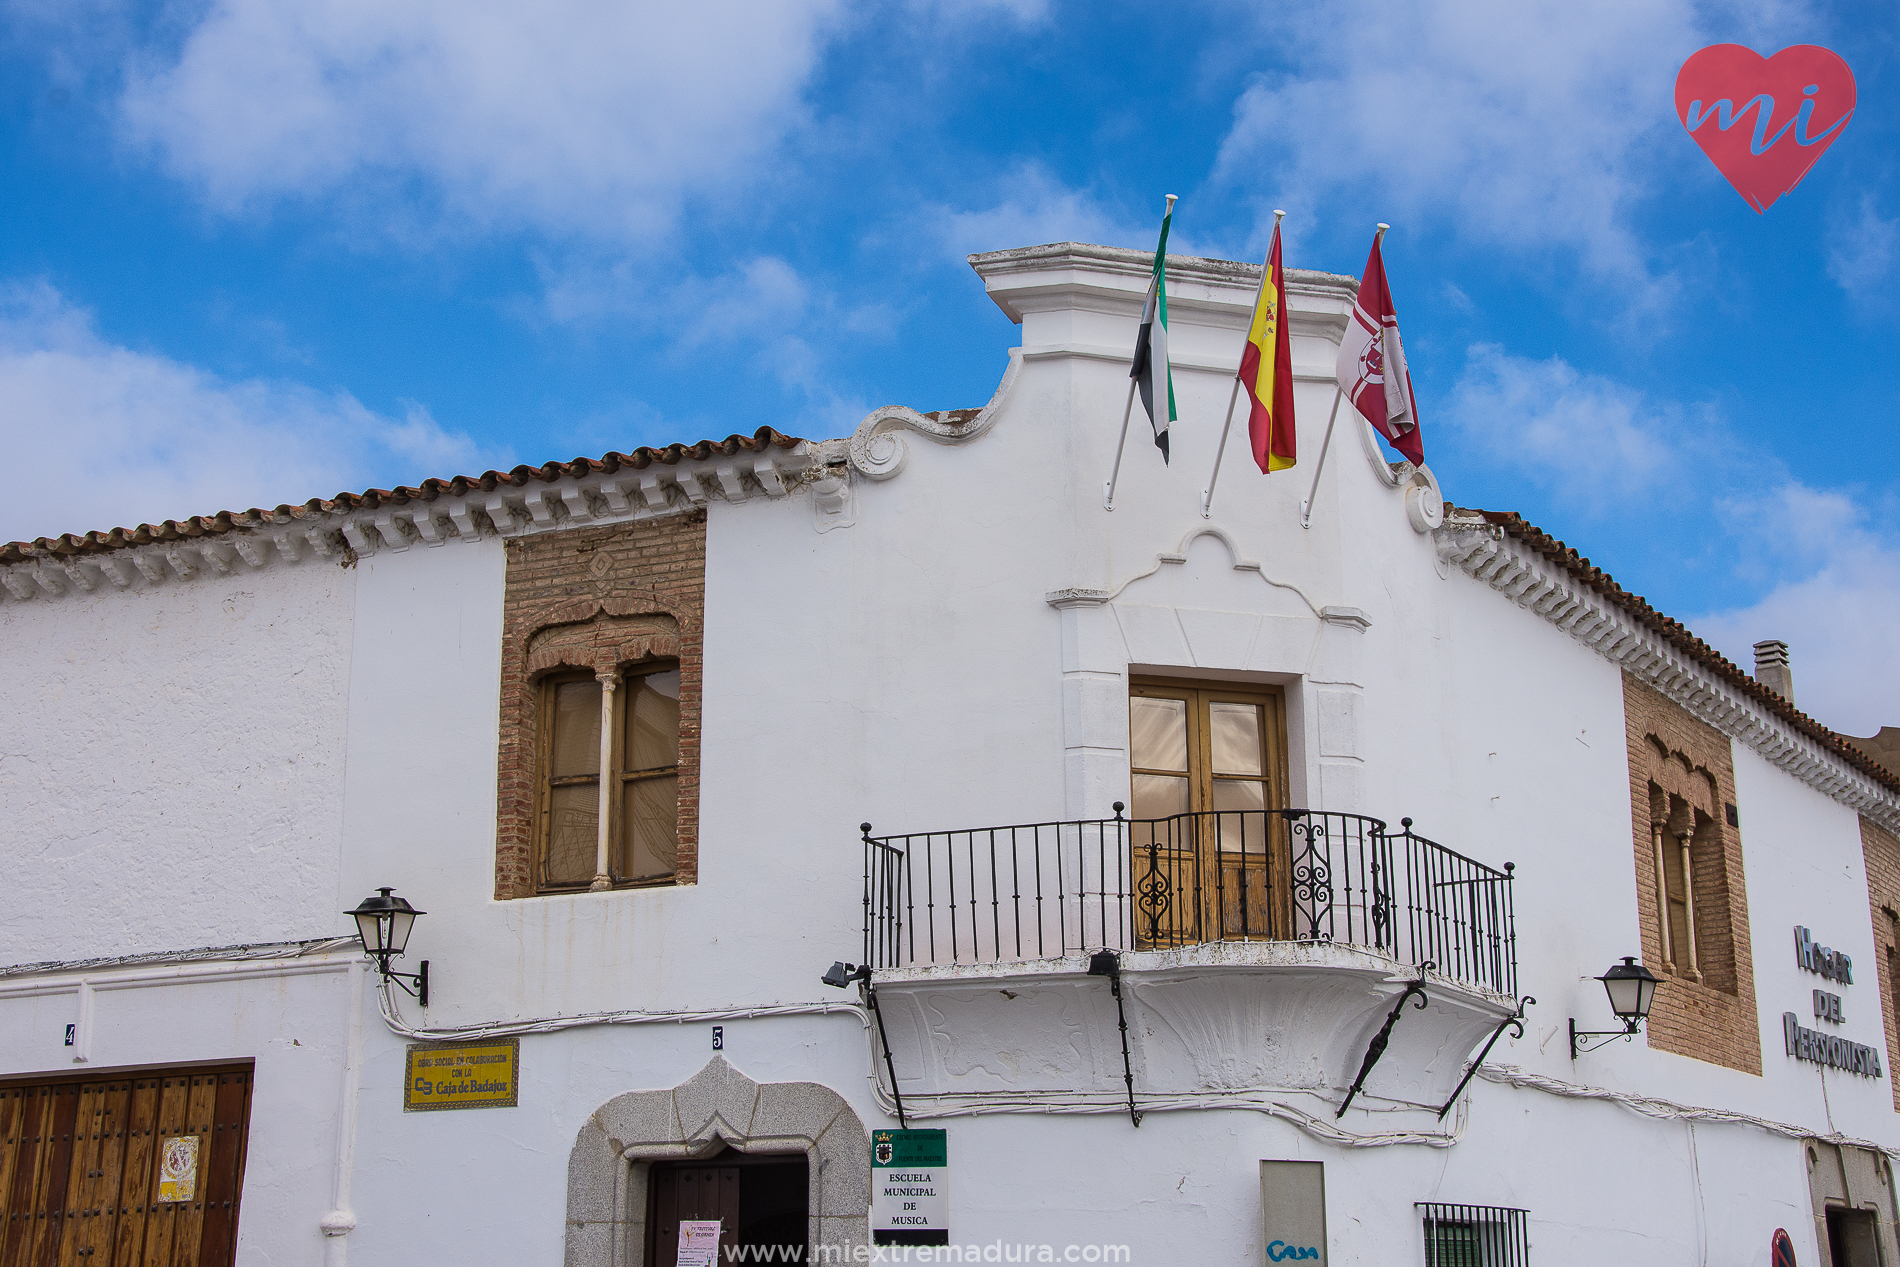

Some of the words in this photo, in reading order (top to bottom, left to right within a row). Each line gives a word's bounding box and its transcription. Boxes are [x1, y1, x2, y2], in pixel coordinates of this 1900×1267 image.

[1813, 989, 1846, 1024] DEL
[66, 1026, 75, 1043] 4
[713, 1029, 722, 1048] 5
[418, 1059, 433, 1068] OBRA
[435, 1056, 454, 1067] SOCIAL
[457, 1056, 464, 1065] EN
[465, 1054, 507, 1065] COLABORACION
[451, 1069, 462, 1078] CON
[464, 1068, 472, 1077] LA
[436, 1081, 457, 1097] Caja
[458, 1080, 469, 1094] de
[470, 1079, 507, 1096] Badajoz
[889, 1173, 931, 1182] ESCUELA
[883, 1188, 937, 1196] MUNICIPAL
[903, 1202, 917, 1210] DE
[891, 1216, 928, 1224] MUSICA
